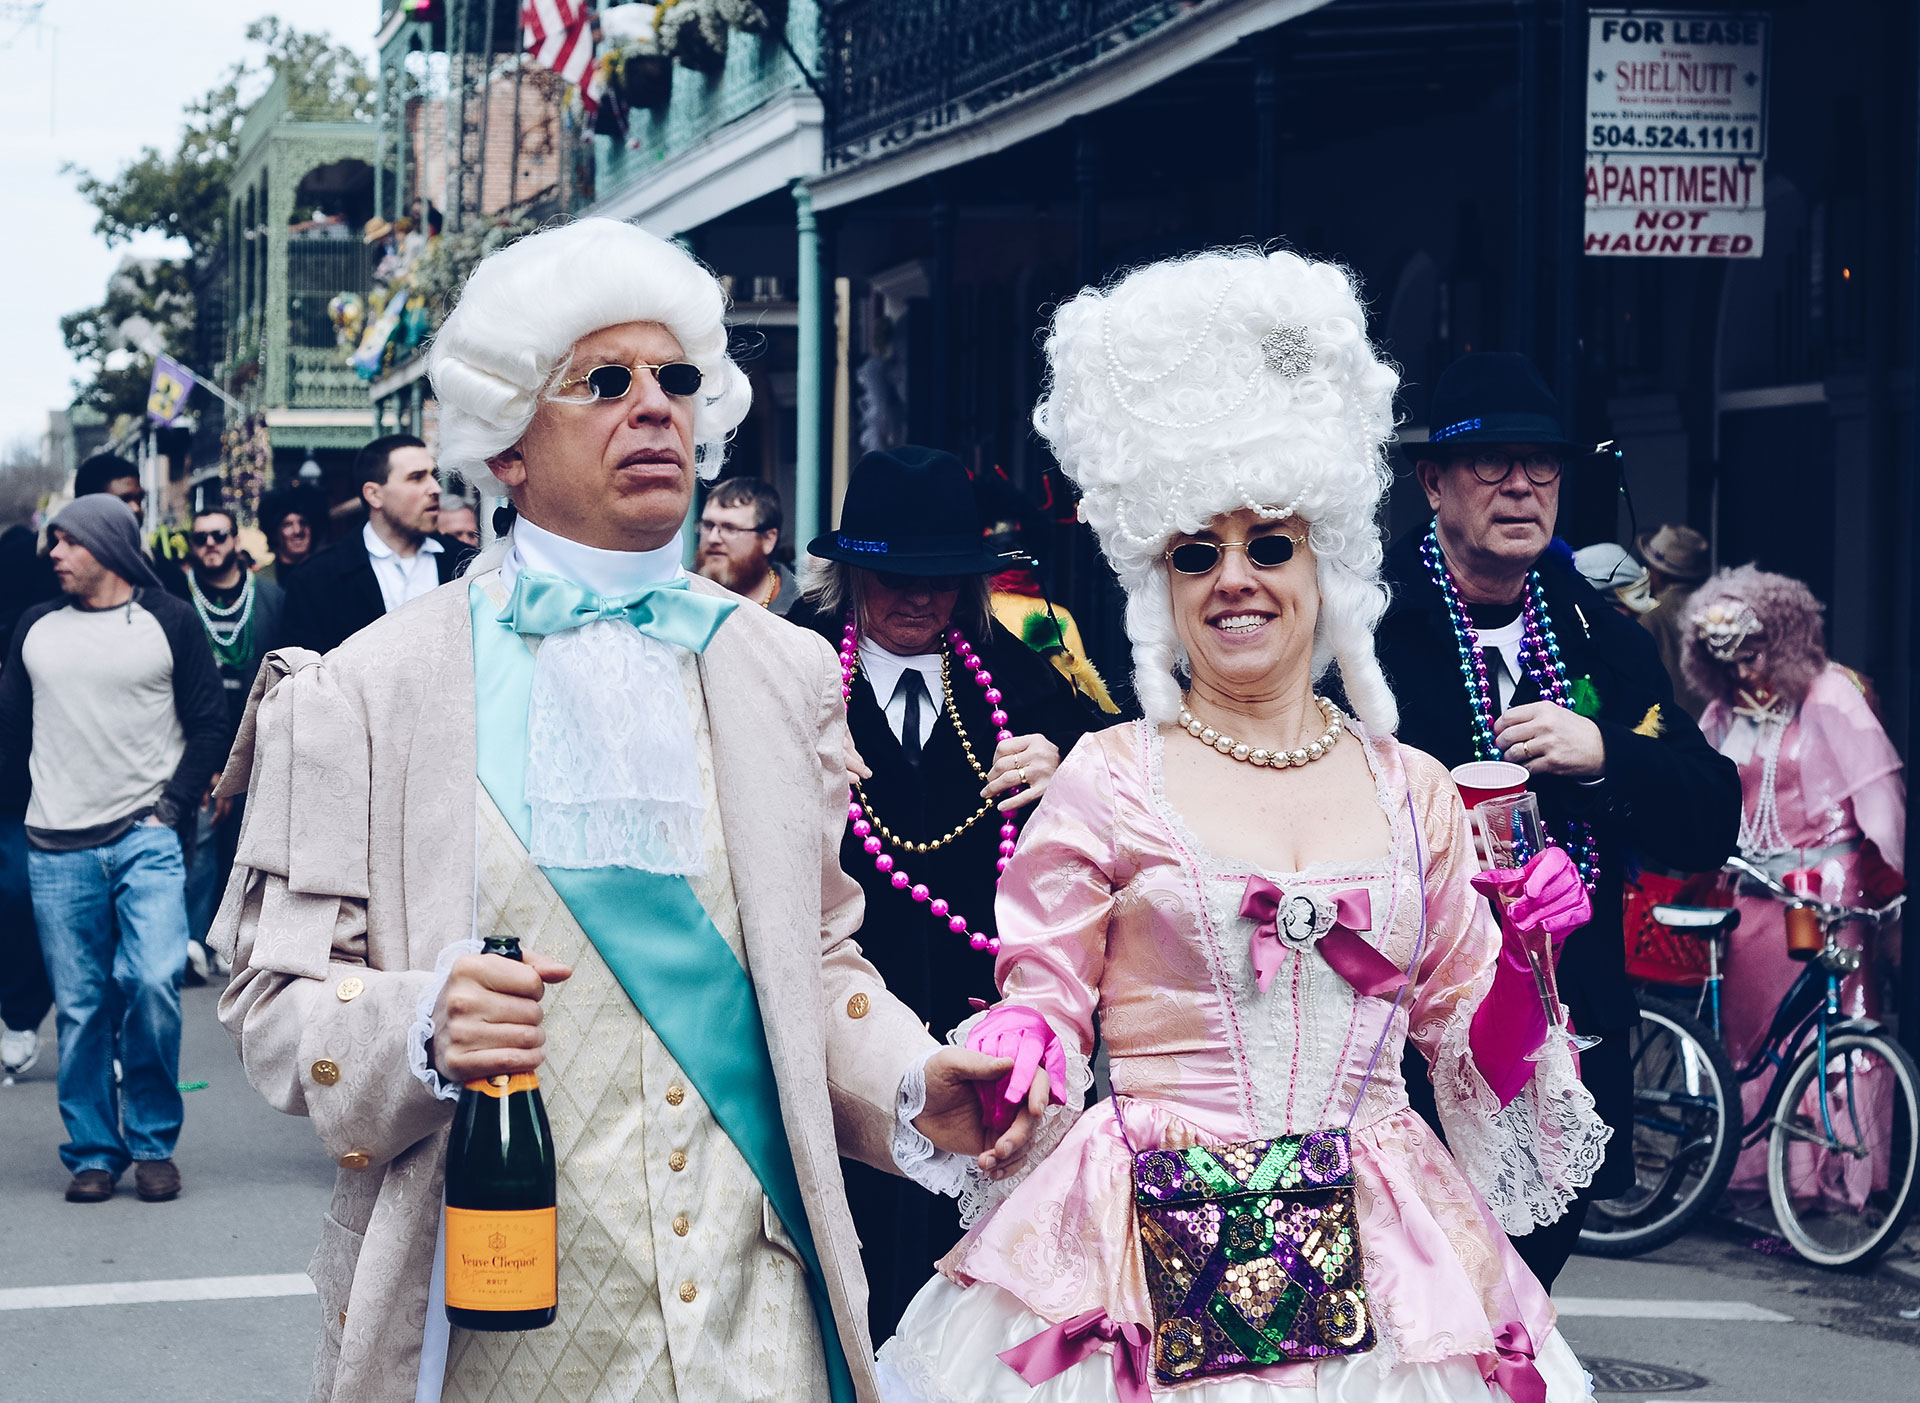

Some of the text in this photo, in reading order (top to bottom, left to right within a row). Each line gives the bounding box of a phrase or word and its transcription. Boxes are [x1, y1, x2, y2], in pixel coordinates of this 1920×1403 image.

[1602, 20, 1759, 45] FOR LEASE
[1616, 61, 1737, 94] SHELNUTT
[1592, 125, 1754, 149] 504.524.1111
[1586, 165, 1756, 203] APARTMENT
[1635, 211, 1709, 231] NOT
[1585, 233, 1753, 254] HAUNTED
[461, 1253, 536, 1270] Veuve Clicquot
